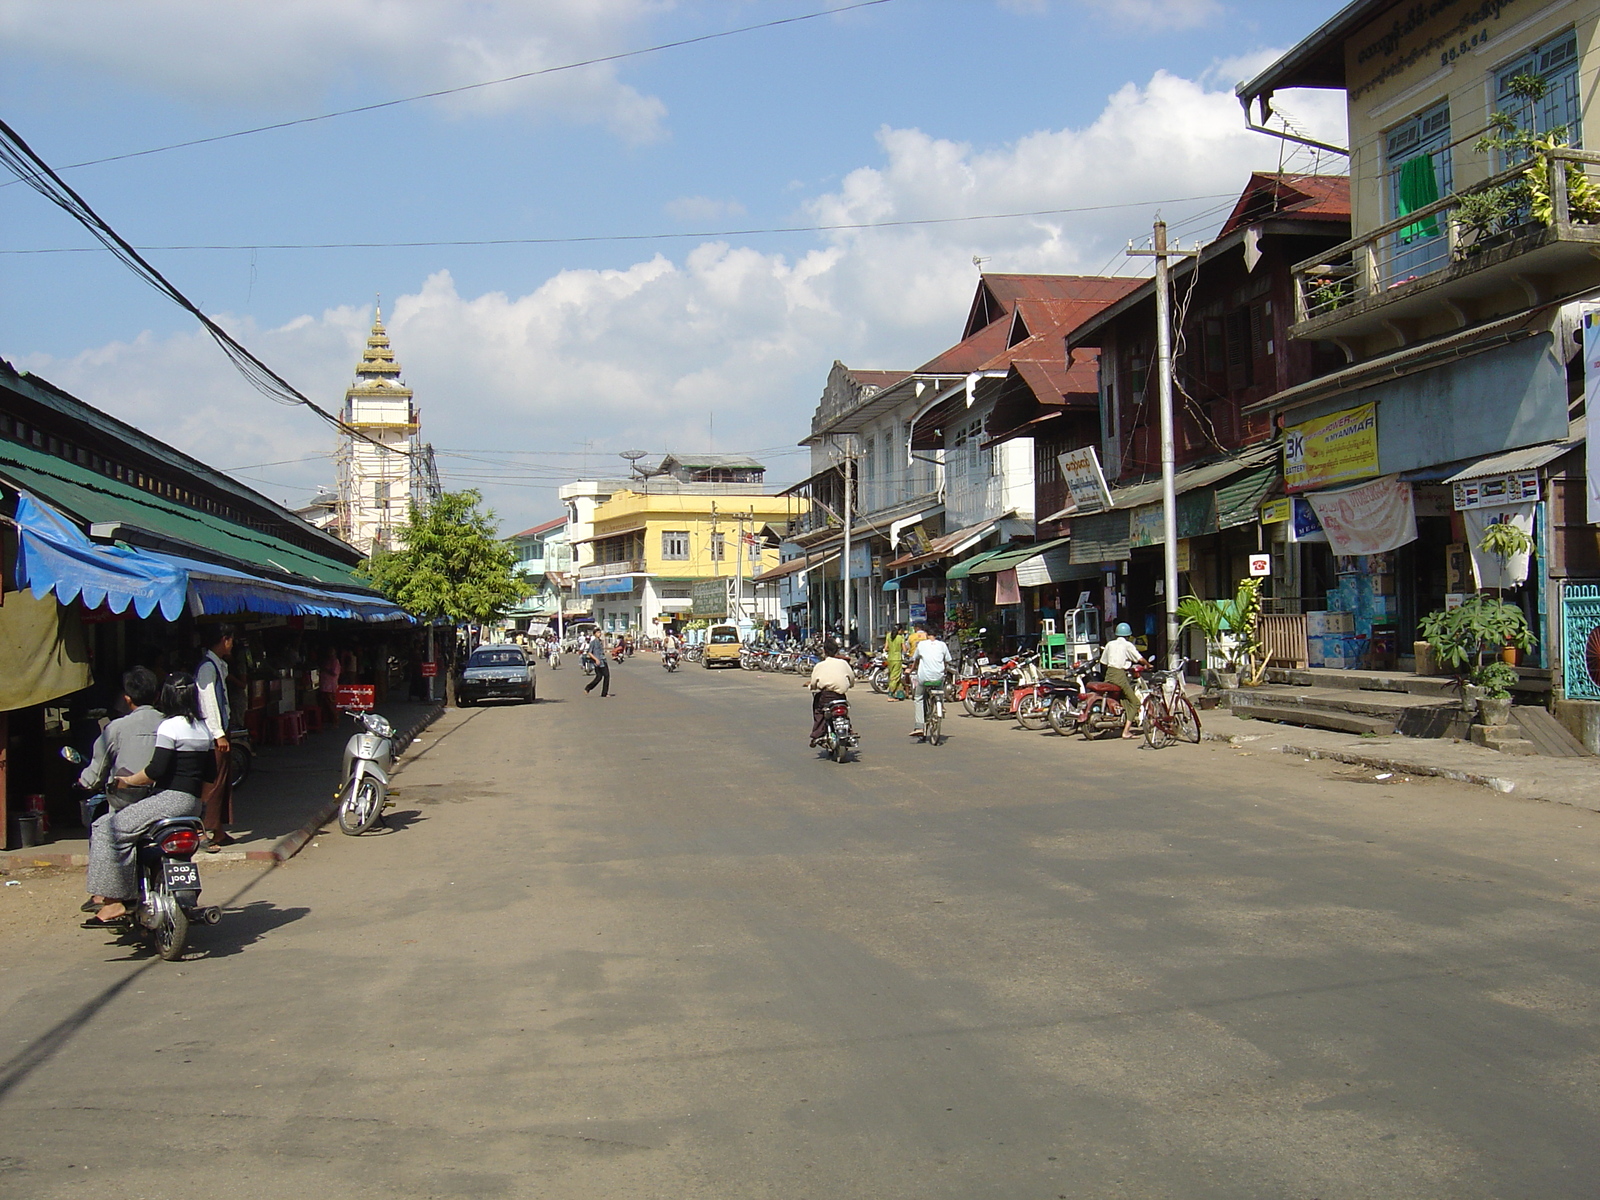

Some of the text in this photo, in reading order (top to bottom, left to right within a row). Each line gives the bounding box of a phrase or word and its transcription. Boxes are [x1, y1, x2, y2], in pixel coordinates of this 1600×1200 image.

[1330, 417, 1374, 442] MYANMAR
[1286, 436, 1304, 459] 3K
[1286, 465, 1305, 475] BATTERY
